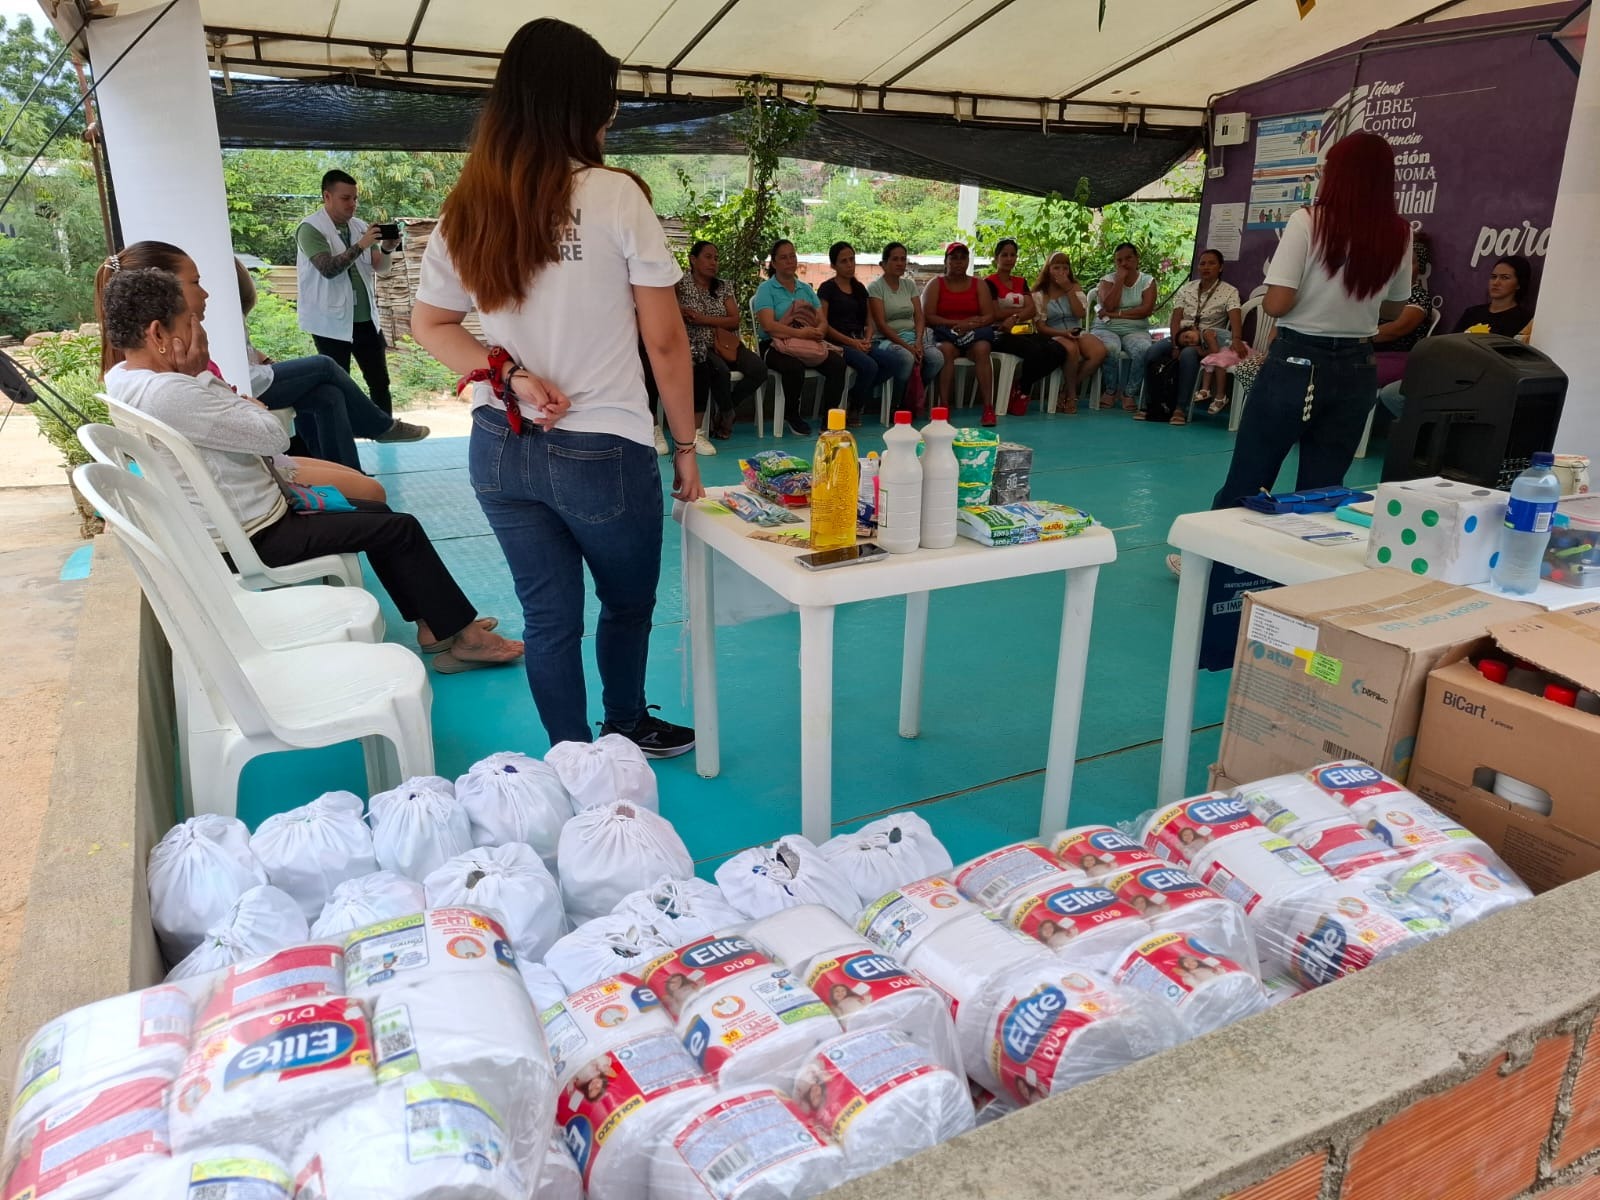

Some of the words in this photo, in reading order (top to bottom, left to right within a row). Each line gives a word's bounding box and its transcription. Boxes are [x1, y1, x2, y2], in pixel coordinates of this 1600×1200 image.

[1368, 81, 1405, 99] Ideas
[1365, 99, 1414, 117] LIBRE
[1363, 112, 1417, 132] Control
[1394, 150, 1431, 166] ción
[1394, 166, 1436, 182] NOMA
[560, 244, 584, 261] RE
[1442, 690, 1488, 719] BiCart
[1325, 768, 1379, 786] Elite
[1192, 800, 1249, 821] Elite
[1054, 888, 1116, 913] Elite
[690, 938, 754, 966] Elite
[1303, 928, 1342, 984] Elite
[1007, 993, 1061, 1056] Elite
[237, 1026, 338, 1070] Elite
[598, 1097, 641, 1141] ROLLAZO
